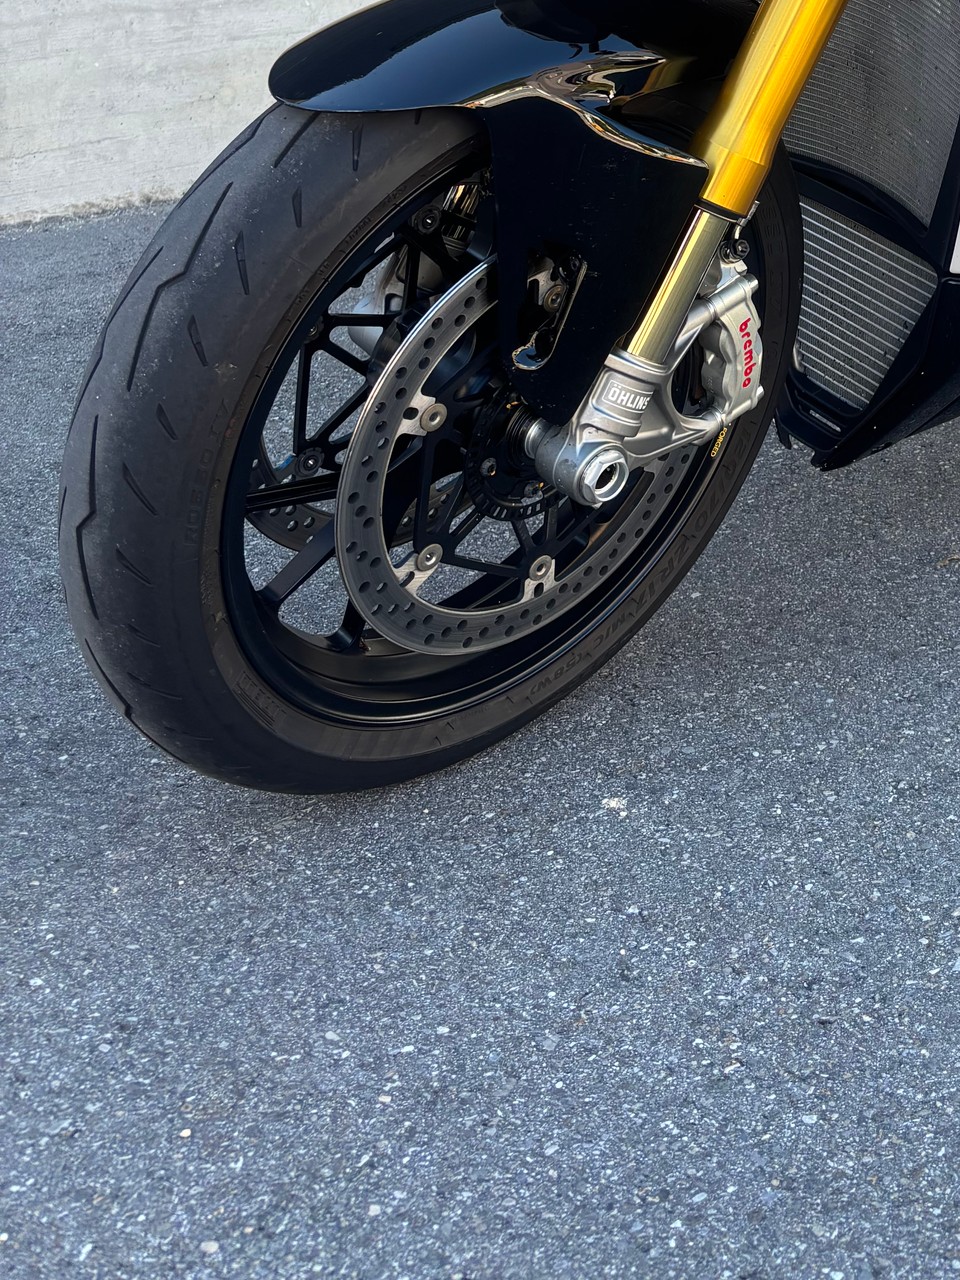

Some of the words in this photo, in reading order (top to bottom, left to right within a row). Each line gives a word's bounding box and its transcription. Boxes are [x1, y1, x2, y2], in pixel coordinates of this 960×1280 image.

[739, 317, 758, 389] brembo
[607, 383, 650, 410] ÖHLINS
[710, 427, 728, 459] FORGED
